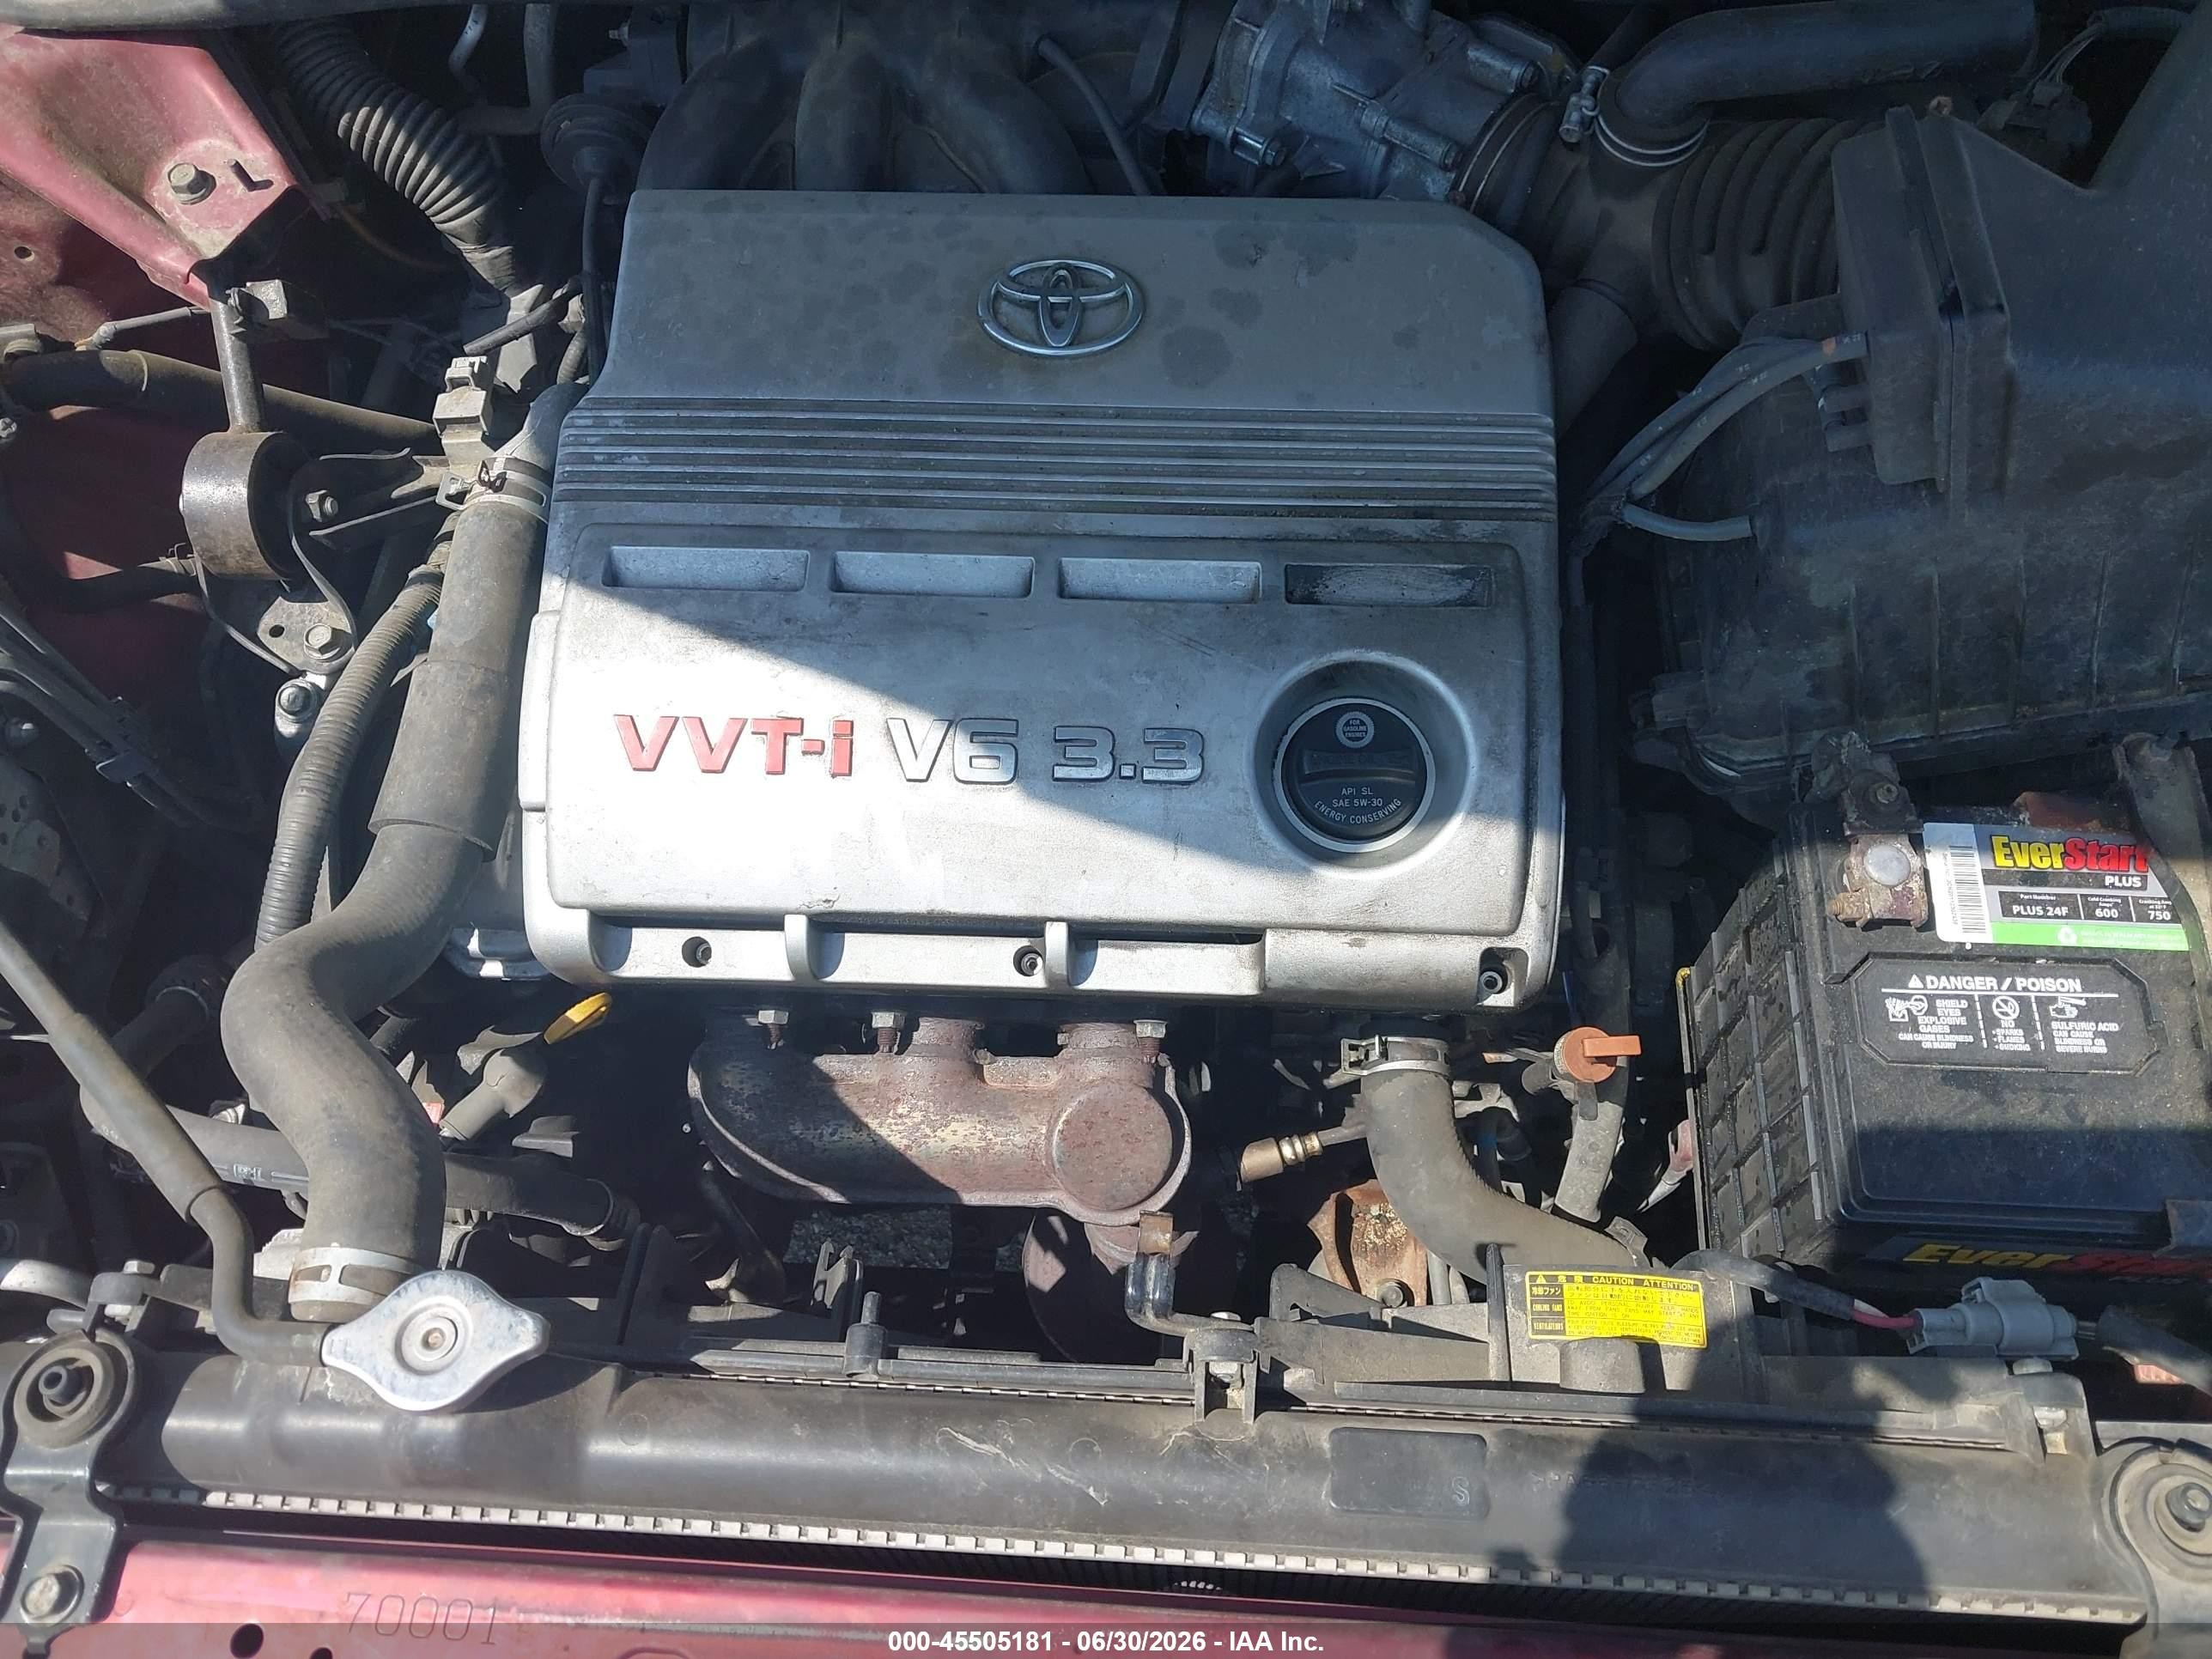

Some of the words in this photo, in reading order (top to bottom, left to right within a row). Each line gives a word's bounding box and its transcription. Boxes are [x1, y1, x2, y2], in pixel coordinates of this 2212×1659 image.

[613, 714, 854, 779] VVT-i
[886, 718, 1020, 785] V6
[1051, 725, 1205, 785] 3.3
[1341, 787, 1356, 796] API
[1332, 799, 1350, 807] SAE
[1353, 798, 1382, 807] 5W-30
[1315, 800, 1346, 823] ENERGY
[1350, 798, 1401, 824] CONSERVING
[1990, 835, 2150, 872] EverStart
[2105, 875, 2142, 888] PLUS
[2012, 905, 2044, 916] PLUS
[2045, 906, 2069, 916] 24F
[2095, 908, 2119, 919] 600
[2148, 910, 2172, 921] 750
[1924, 975, 1997, 990] DANGER
[2015, 976, 2082, 992] POISON
[1936, 999, 1968, 1008] SHIELD
[1936, 1008, 1961, 1017] EYES
[1917, 1016, 1967, 1025] EXPLOSIVE
[2000, 1019, 2015, 1028] NO
[2051, 1021, 2096, 1030] SULFURIC
[2098, 1023, 2119, 1031] ACID
[1592, 1276, 1634, 1285] CAUTION
[1643, 1279, 1693, 1291] ATTENTION
[345, 1591, 497, 1646] 70001
